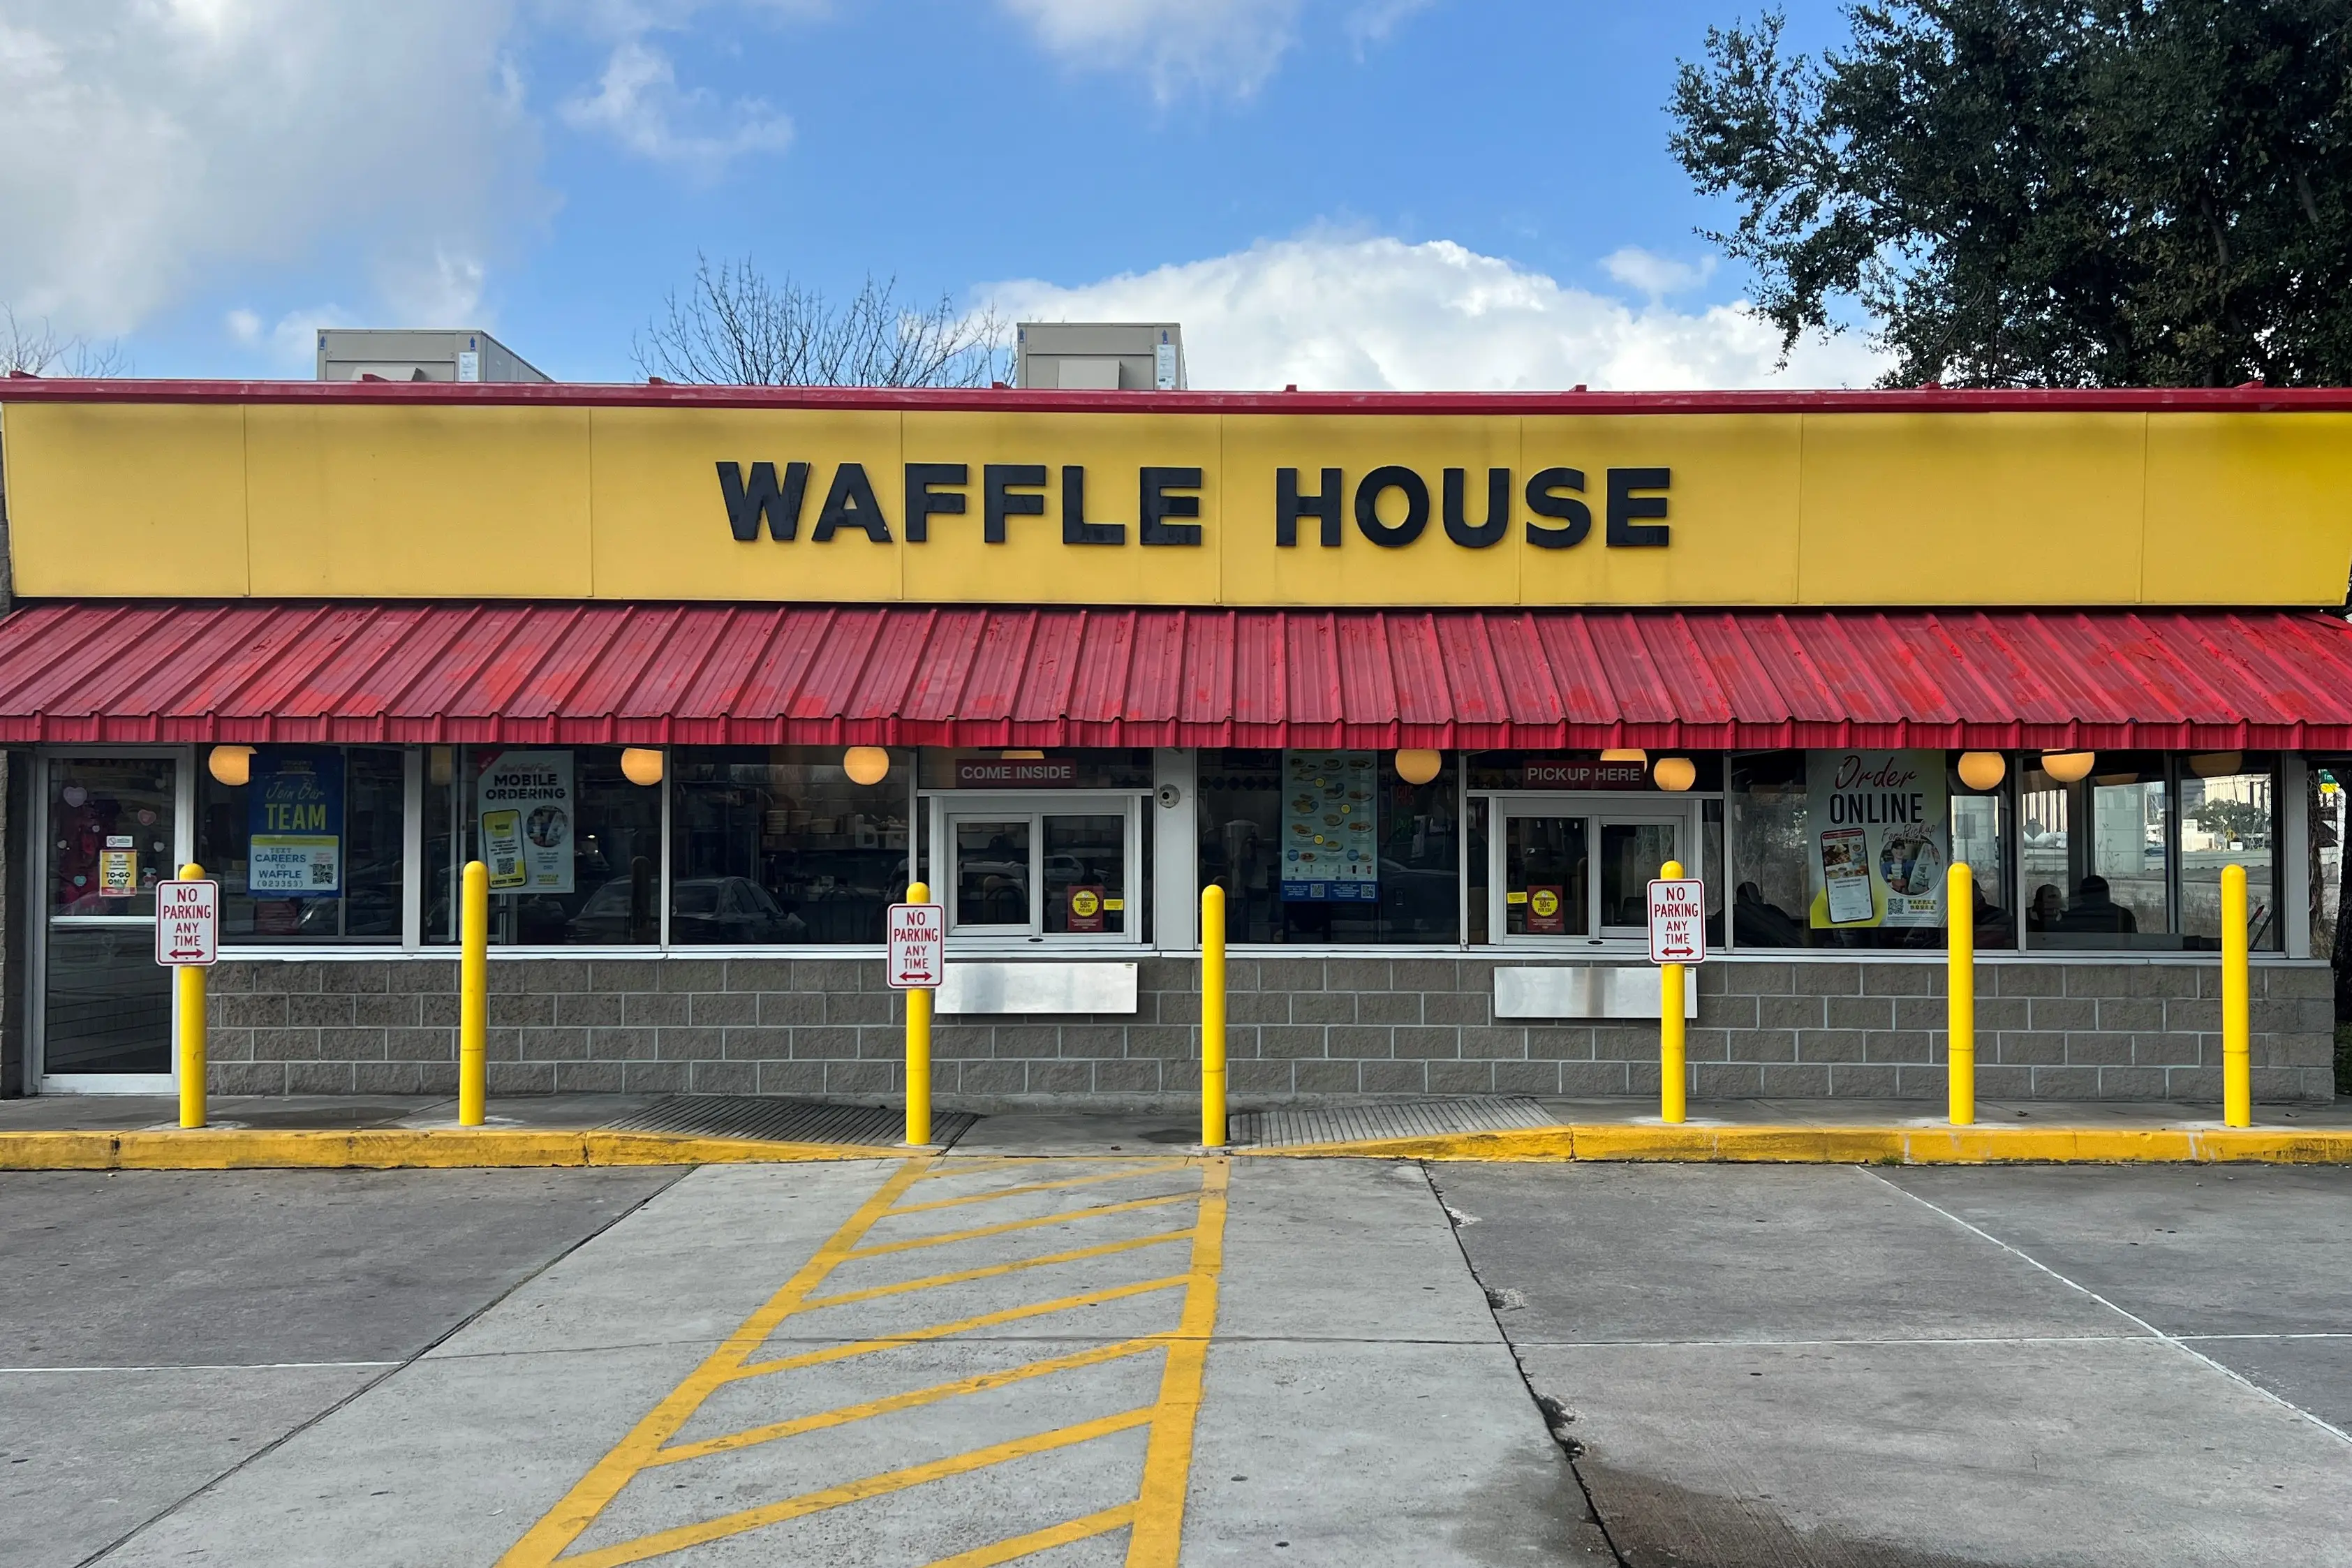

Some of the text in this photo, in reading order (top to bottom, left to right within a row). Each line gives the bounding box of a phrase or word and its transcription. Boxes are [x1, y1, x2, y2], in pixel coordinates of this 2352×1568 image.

[716, 461, 1671, 549] WAFFLE HOUSE
[961, 766, 1072, 779] COME INSIDE
[1527, 767, 1641, 781] PICKUP HERE
[1835, 755, 1918, 790] Order
[493, 774, 558, 787] MOBILE
[265, 781, 325, 800] Join Our
[485, 787, 566, 800] ORDERING
[1829, 793, 1924, 824] ONLINE
[265, 804, 326, 831] TEAM
[255, 854, 306, 863] CAREERS
[258, 870, 302, 879] WAFFLE
[177, 888, 198, 903] NO
[1666, 887, 1685, 901] NO
[163, 904, 211, 919] PARKING
[1654, 903, 1699, 917] PARKING
[906, 911, 926, 926] NO
[1666, 920, 1688, 931] ANY
[175, 922, 200, 933] ANY
[173, 935, 201, 947] TIME
[894, 928, 938, 942] PARKING
[1664, 933, 1690, 945] TIME
[905, 945, 927, 956] ANY
[903, 958, 929, 969] TIME
